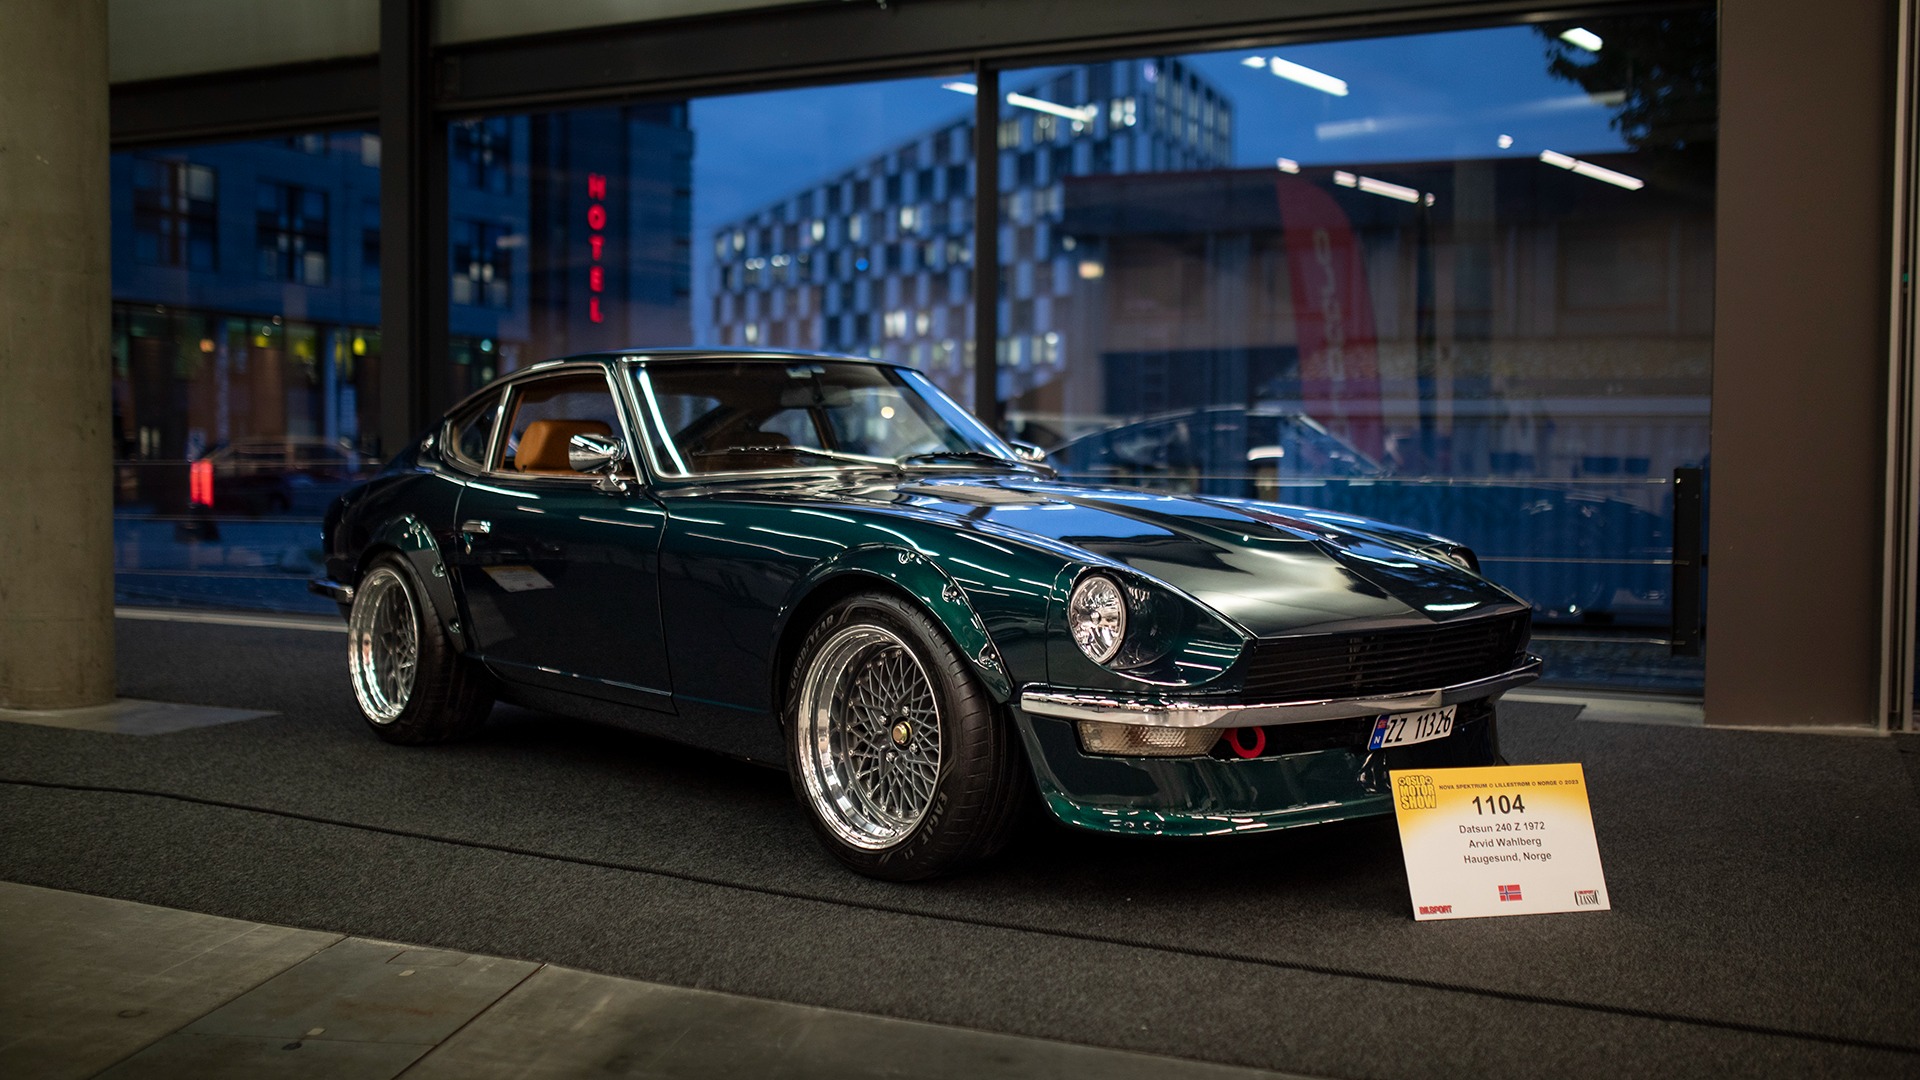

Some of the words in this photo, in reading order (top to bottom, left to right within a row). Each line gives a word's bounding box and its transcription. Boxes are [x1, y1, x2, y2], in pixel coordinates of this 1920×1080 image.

[587, 173, 607, 323] HOTEL
[1384, 717, 1408, 744] ZZ
[1414, 708, 1454, 740] 11326
[1373, 736, 1381, 744] N
[1400, 784, 1435, 797] MOTOR
[1401, 795, 1437, 810] SHOW
[1472, 794, 1525, 815] 1104
[1459, 824, 1493, 834] Datsun
[1495, 822, 1512, 832] 240
[1514, 822, 1521, 831] Z
[1524, 821, 1546, 831] 1972
[1469, 839, 1494, 848] Arvid
[1496, 837, 1542, 847] Wahlberg
[1463, 852, 1521, 865] Haugesund,
[1522, 851, 1552, 862] Norge
